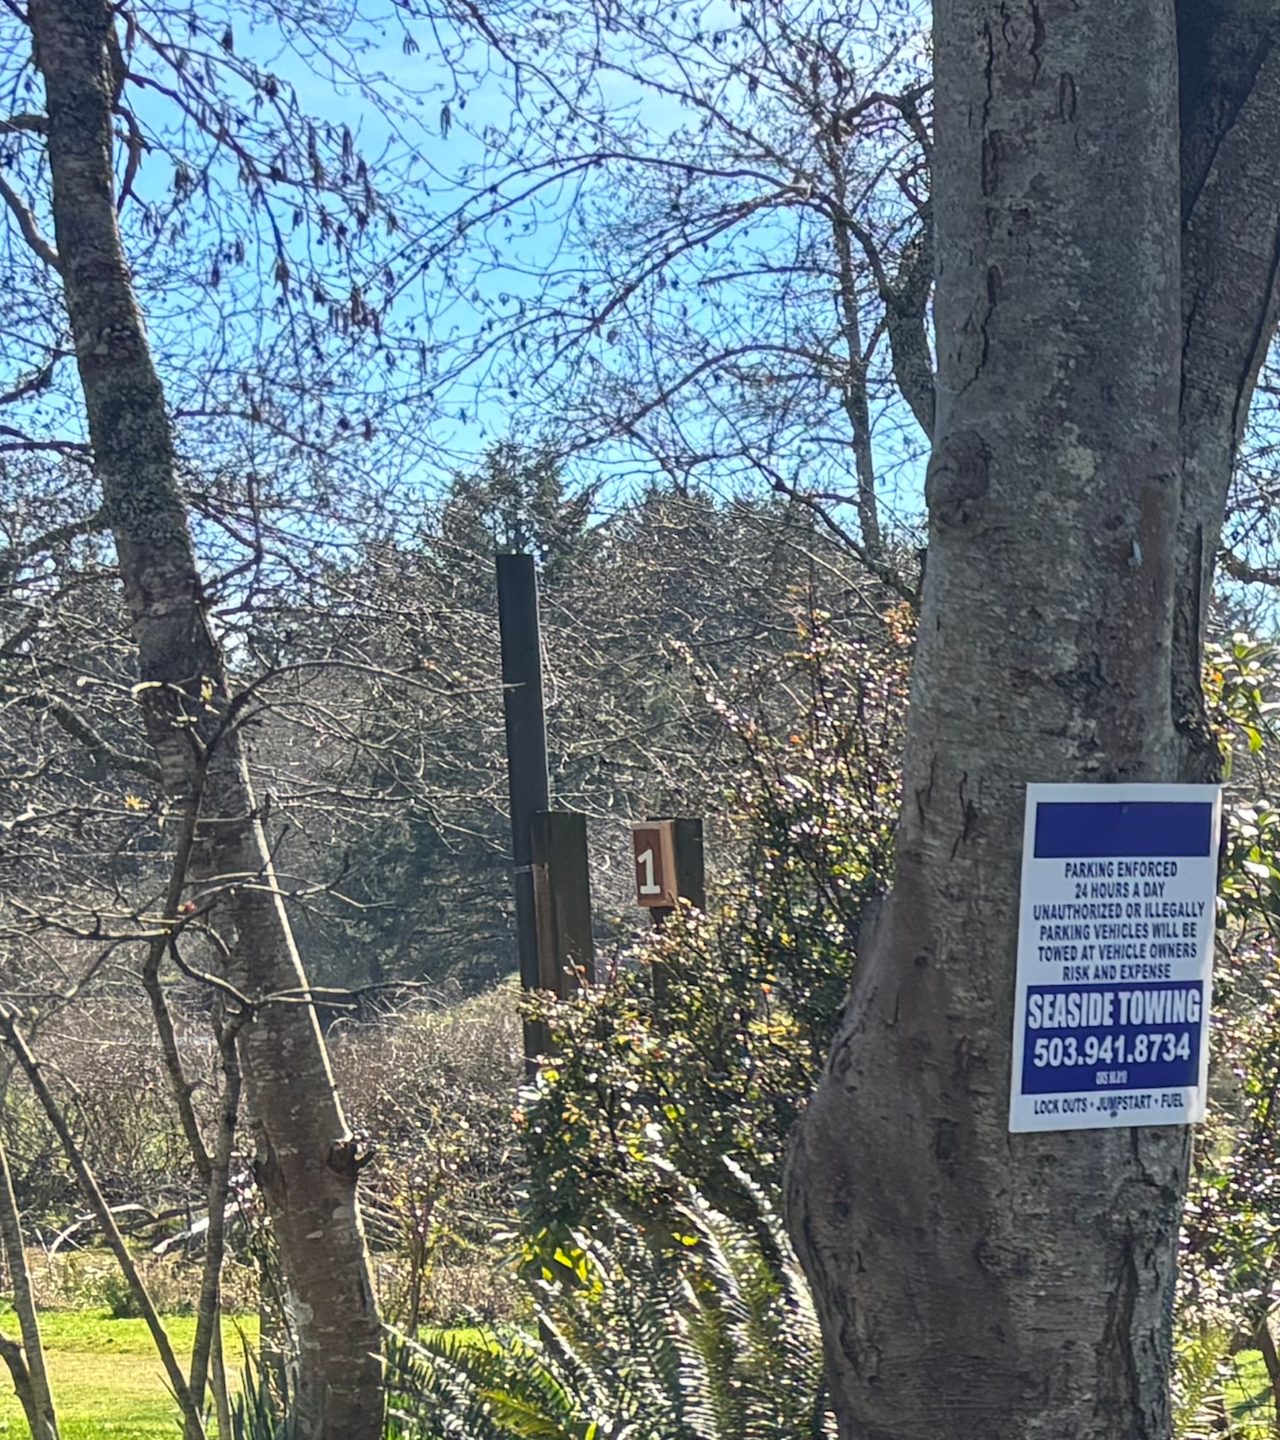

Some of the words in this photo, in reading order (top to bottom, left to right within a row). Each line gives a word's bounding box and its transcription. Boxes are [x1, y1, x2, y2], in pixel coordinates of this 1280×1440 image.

[637, 848, 661, 895] 1
[1065, 862, 1114, 878] PARKING
[1118, 861, 1177, 877] ENFORCED
[1075, 883, 1088, 899] 24
[1091, 882, 1129, 899] HOURS
[1133, 882, 1141, 898] A
[1144, 881, 1166, 898] DAY
[1033, 903, 1123, 920] UNAUTHORIZED
[1126, 902, 1142, 919] OR
[1145, 901, 1206, 918] ILLEGALLY
[1040, 924, 1090, 941] PARKING
[1093, 923, 1149, 940] VEHICLES
[1152, 922, 1179, 939] WILL
[1182, 922, 1197, 938] BE
[1038, 945, 1078, 962] TOWED
[1081, 945, 1095, 961] AT
[1098, 943, 1147, 961] VEHICLE
[1150, 942, 1198, 959] OWNERS
[1062, 965, 1090, 981] RISK
[1093, 964, 1117, 980] AND
[1120, 963, 1172, 980] EXPENSE
[1027, 991, 1115, 1029] SEASIDE
[1118, 988, 1200, 1026] TOWING
[1033, 1032, 1191, 1068] 503.941.8734
[1033, 1099, 1060, 1115] LOCK
[1062, 1097, 1088, 1113] OUTS
[1096, 1094, 1153, 1112] JUMPSTART
[1160, 1093, 1184, 1108] FUEL
